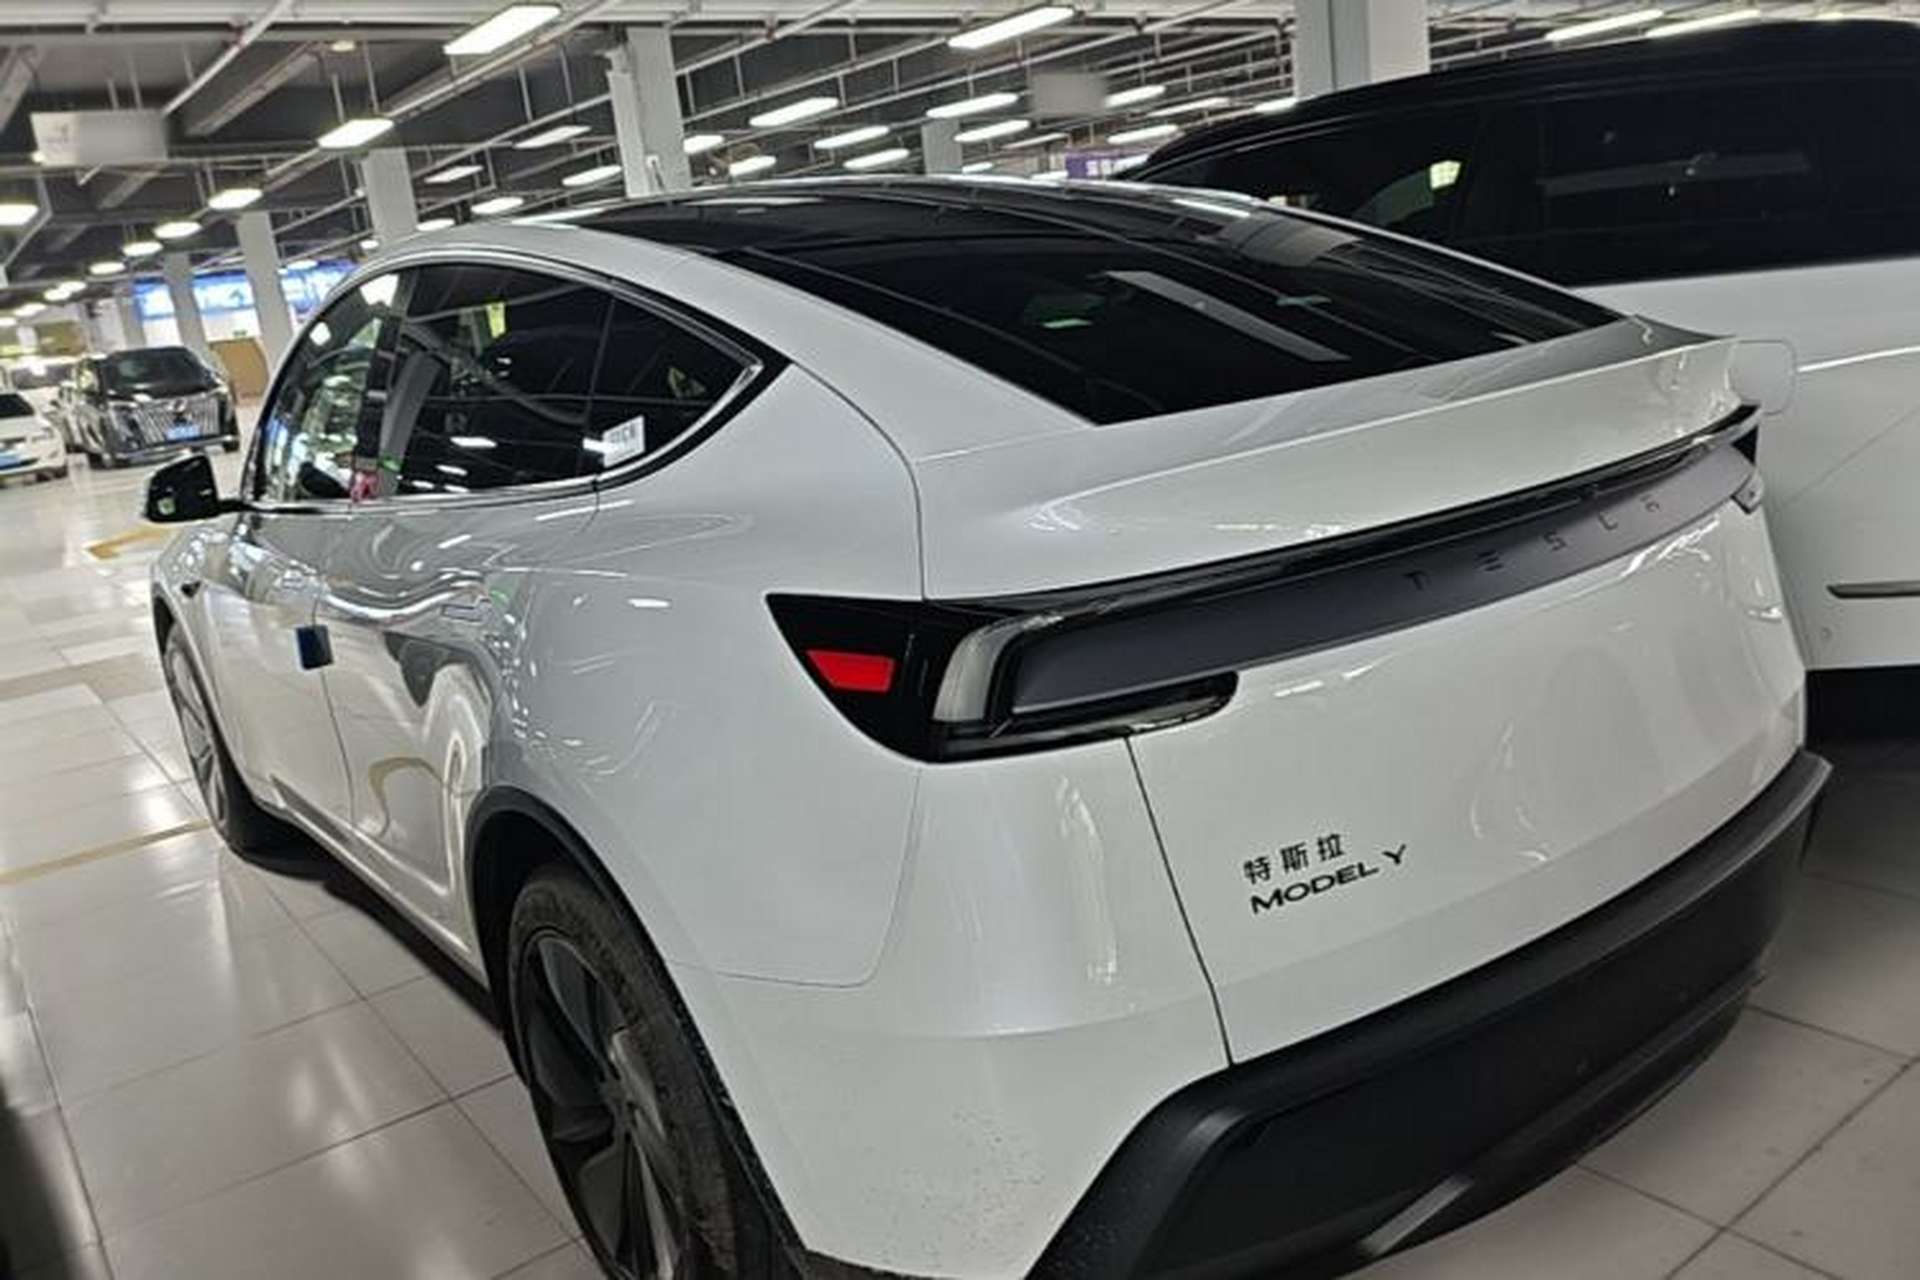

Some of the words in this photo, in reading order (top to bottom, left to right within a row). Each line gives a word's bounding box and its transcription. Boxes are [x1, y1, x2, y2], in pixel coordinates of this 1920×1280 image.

[1403, 495, 1660, 591] TESLA
[1243, 833, 1345, 884] 特斯拉
[1250, 862, 1379, 914] MODEL
[1382, 843, 1406, 865] Y
